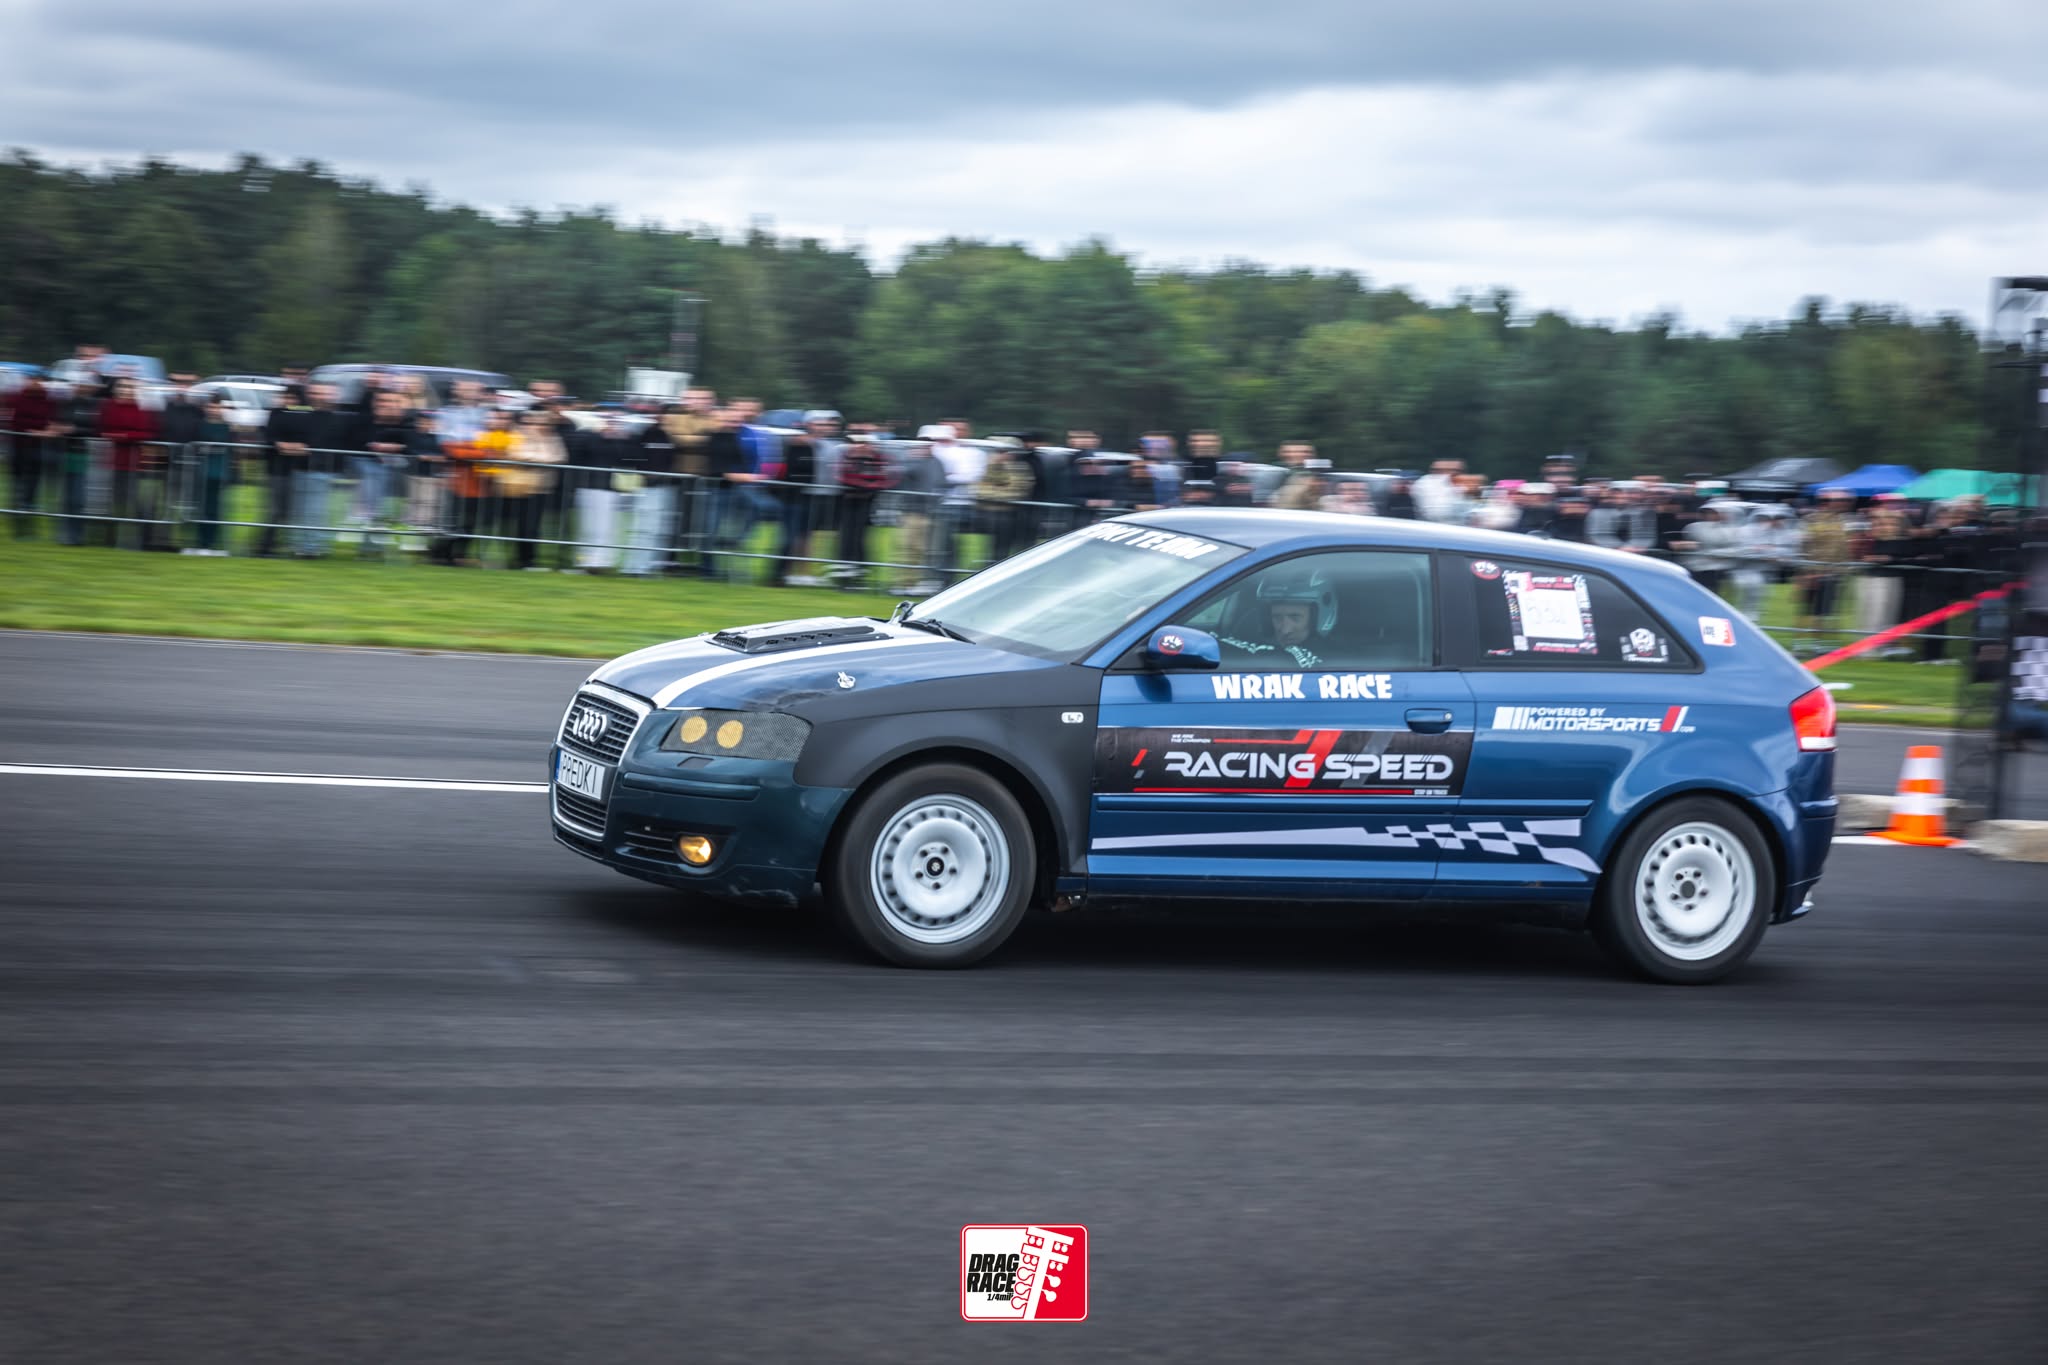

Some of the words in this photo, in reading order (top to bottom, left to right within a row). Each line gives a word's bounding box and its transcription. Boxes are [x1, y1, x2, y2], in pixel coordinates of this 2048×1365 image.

[1211, 673, 1306, 700] WRAK
[1318, 673, 1393, 700] RACE
[1529, 707, 1588, 717] POWERED
[1590, 707, 1606, 717] BY
[1526, 716, 1662, 732] MOTORSPORTS
[1163, 751, 1316, 780] RACING
[1322, 752, 1454, 781] SPEED
